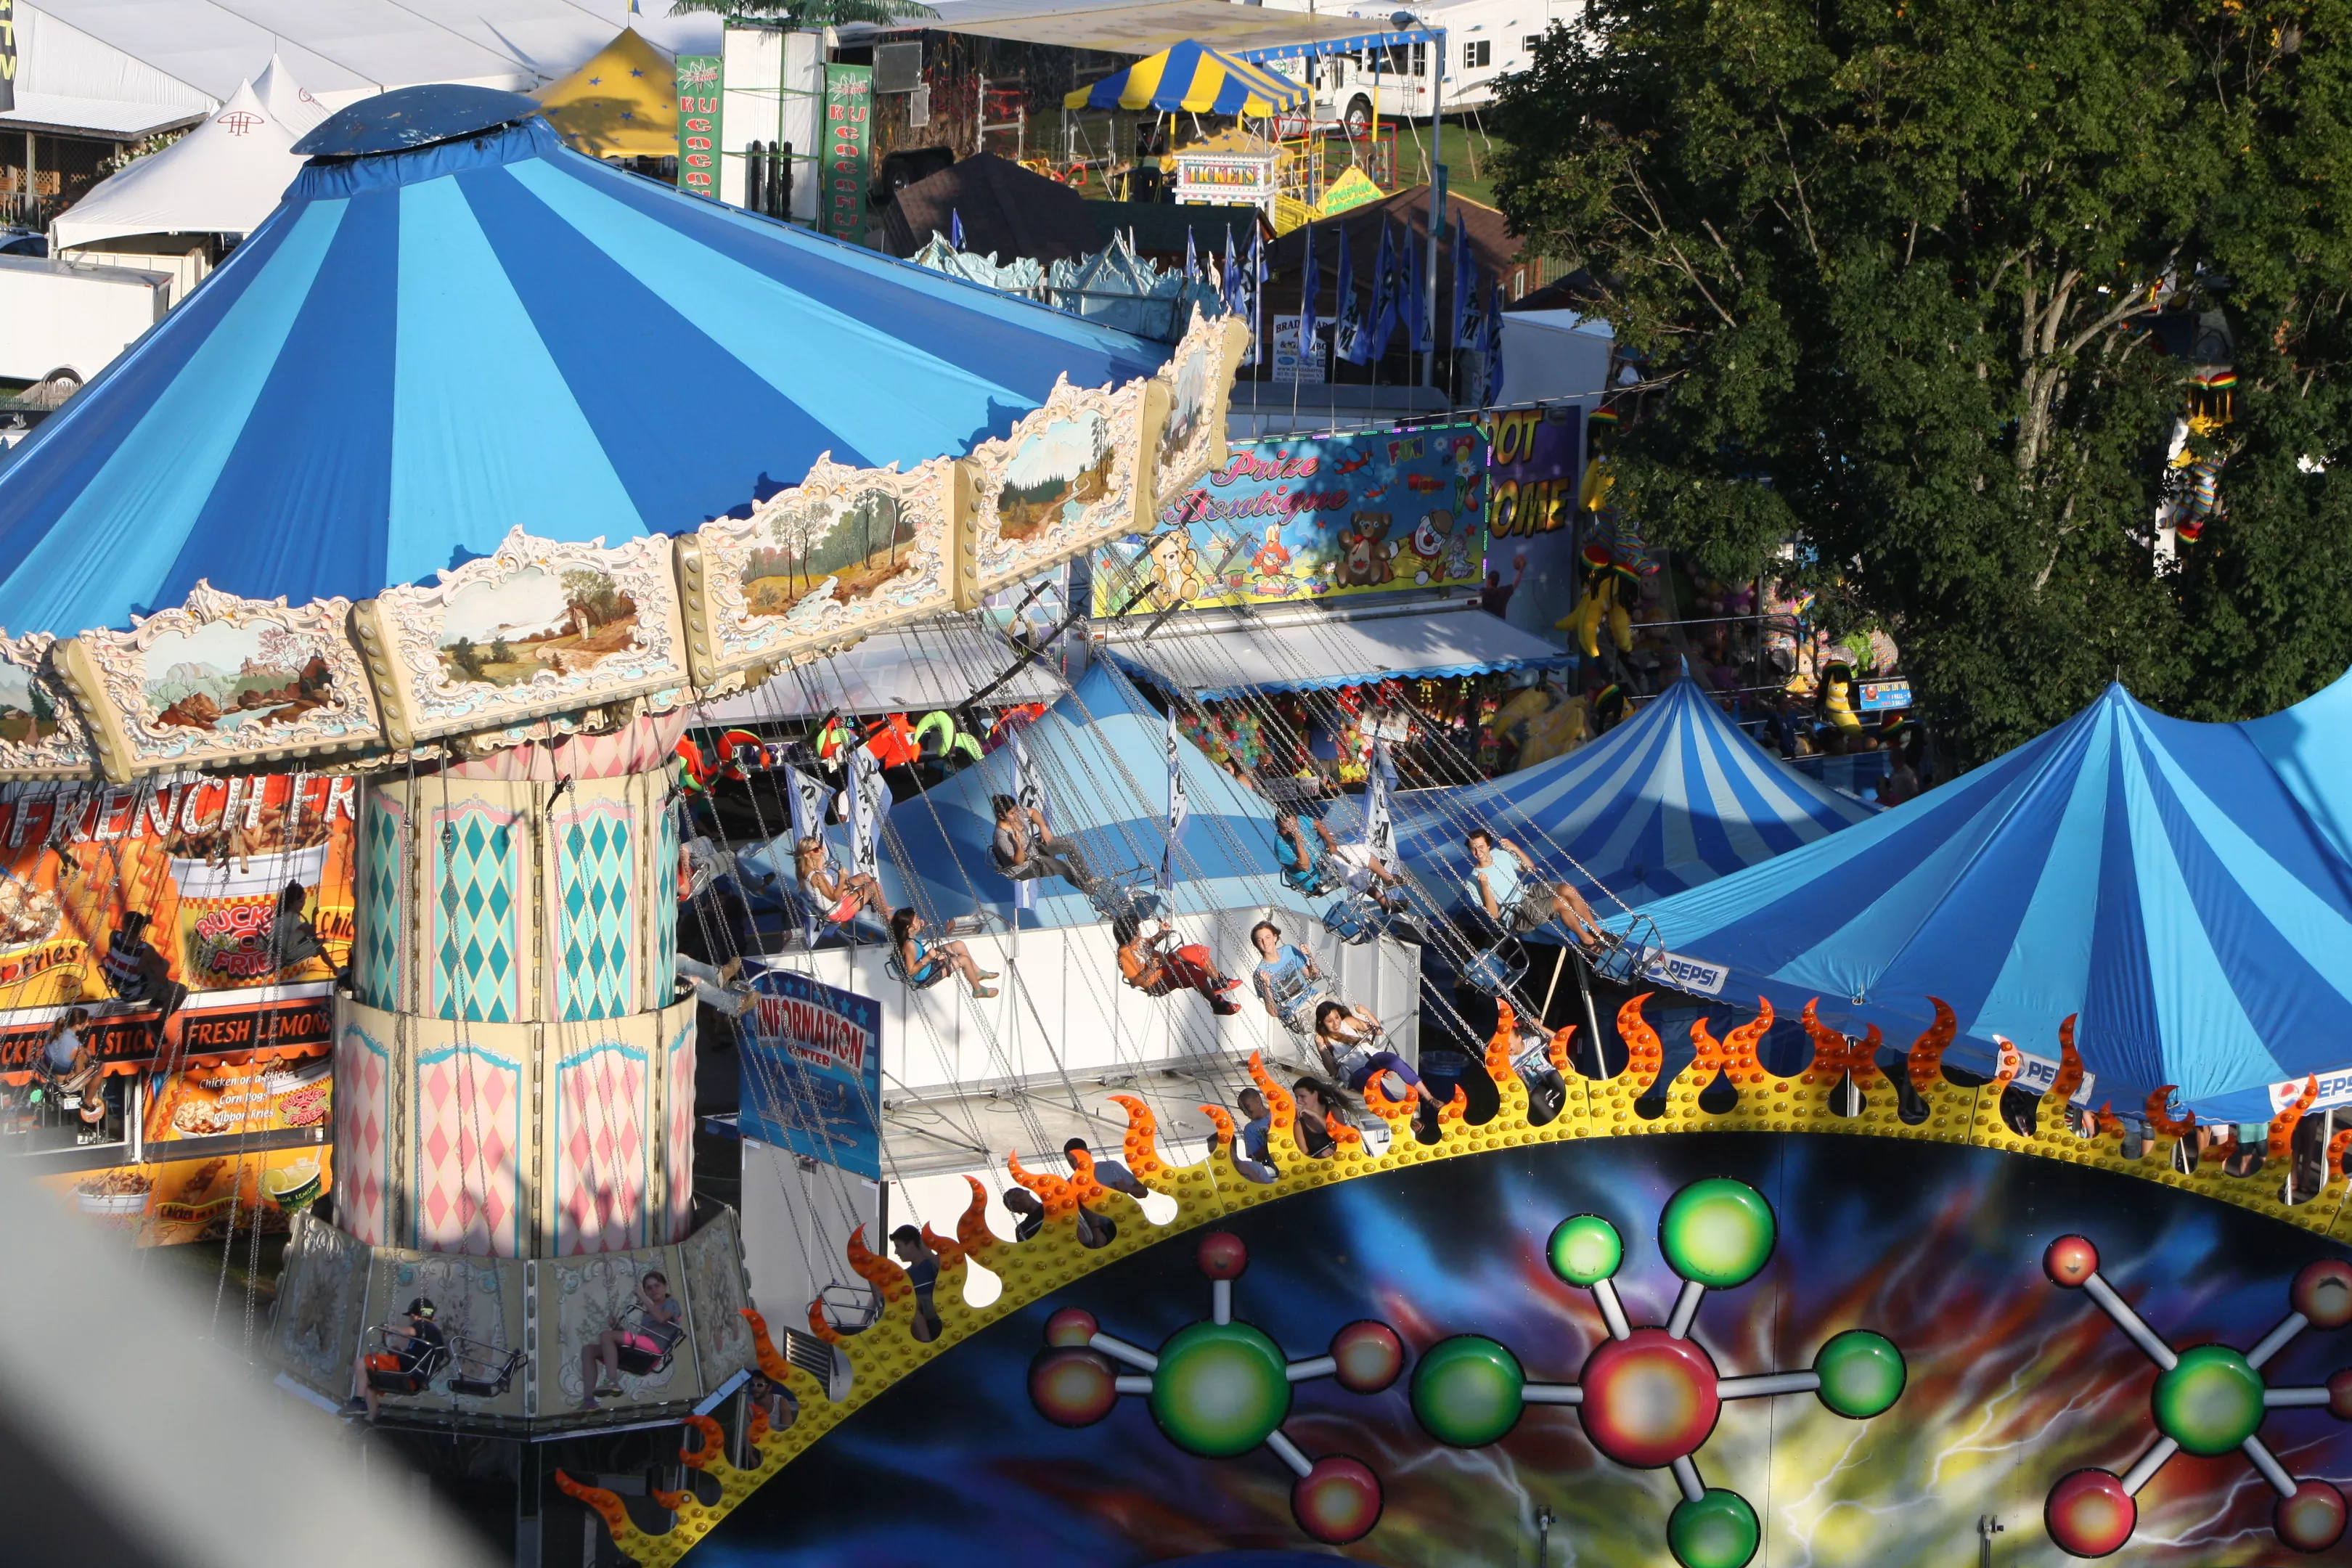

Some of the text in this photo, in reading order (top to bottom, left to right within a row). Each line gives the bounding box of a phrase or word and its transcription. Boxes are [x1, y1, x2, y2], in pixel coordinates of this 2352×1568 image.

[680, 97, 718, 113] RU
[830, 105, 866, 122] RU
[1188, 166, 1255, 185] TICKETS
[1469, 409, 1543, 465] OOT
[1387, 435, 1425, 466] FUN
[1211, 449, 1320, 488] Prize
[1163, 485, 1349, 525] Boutique
[7, 771, 356, 849] FRENCH FR
[196, 905, 274, 942] BUCK
[321, 909, 353, 939] Chic
[23, 945, 78, 977] Fries
[211, 950, 274, 976] FRIE
[1669, 959, 1719, 987] PEPSI
[104, 1028, 155, 1055] STICK
[187, 1019, 250, 1045] FRESH
[757, 997, 865, 1069] INFORMATION
[787, 1044, 830, 1067] CENTER
[199, 1076, 240, 1090] Chicken
[2317, 1075, 2352, 1099] EPS
[219, 1094, 242, 1106] Corn
[279, 1088, 327, 1112] BUCKET
[250, 1108, 274, 1119] Fries
[290, 1106, 325, 1124] FRIES
[160, 1205, 194, 1220] Chicken
